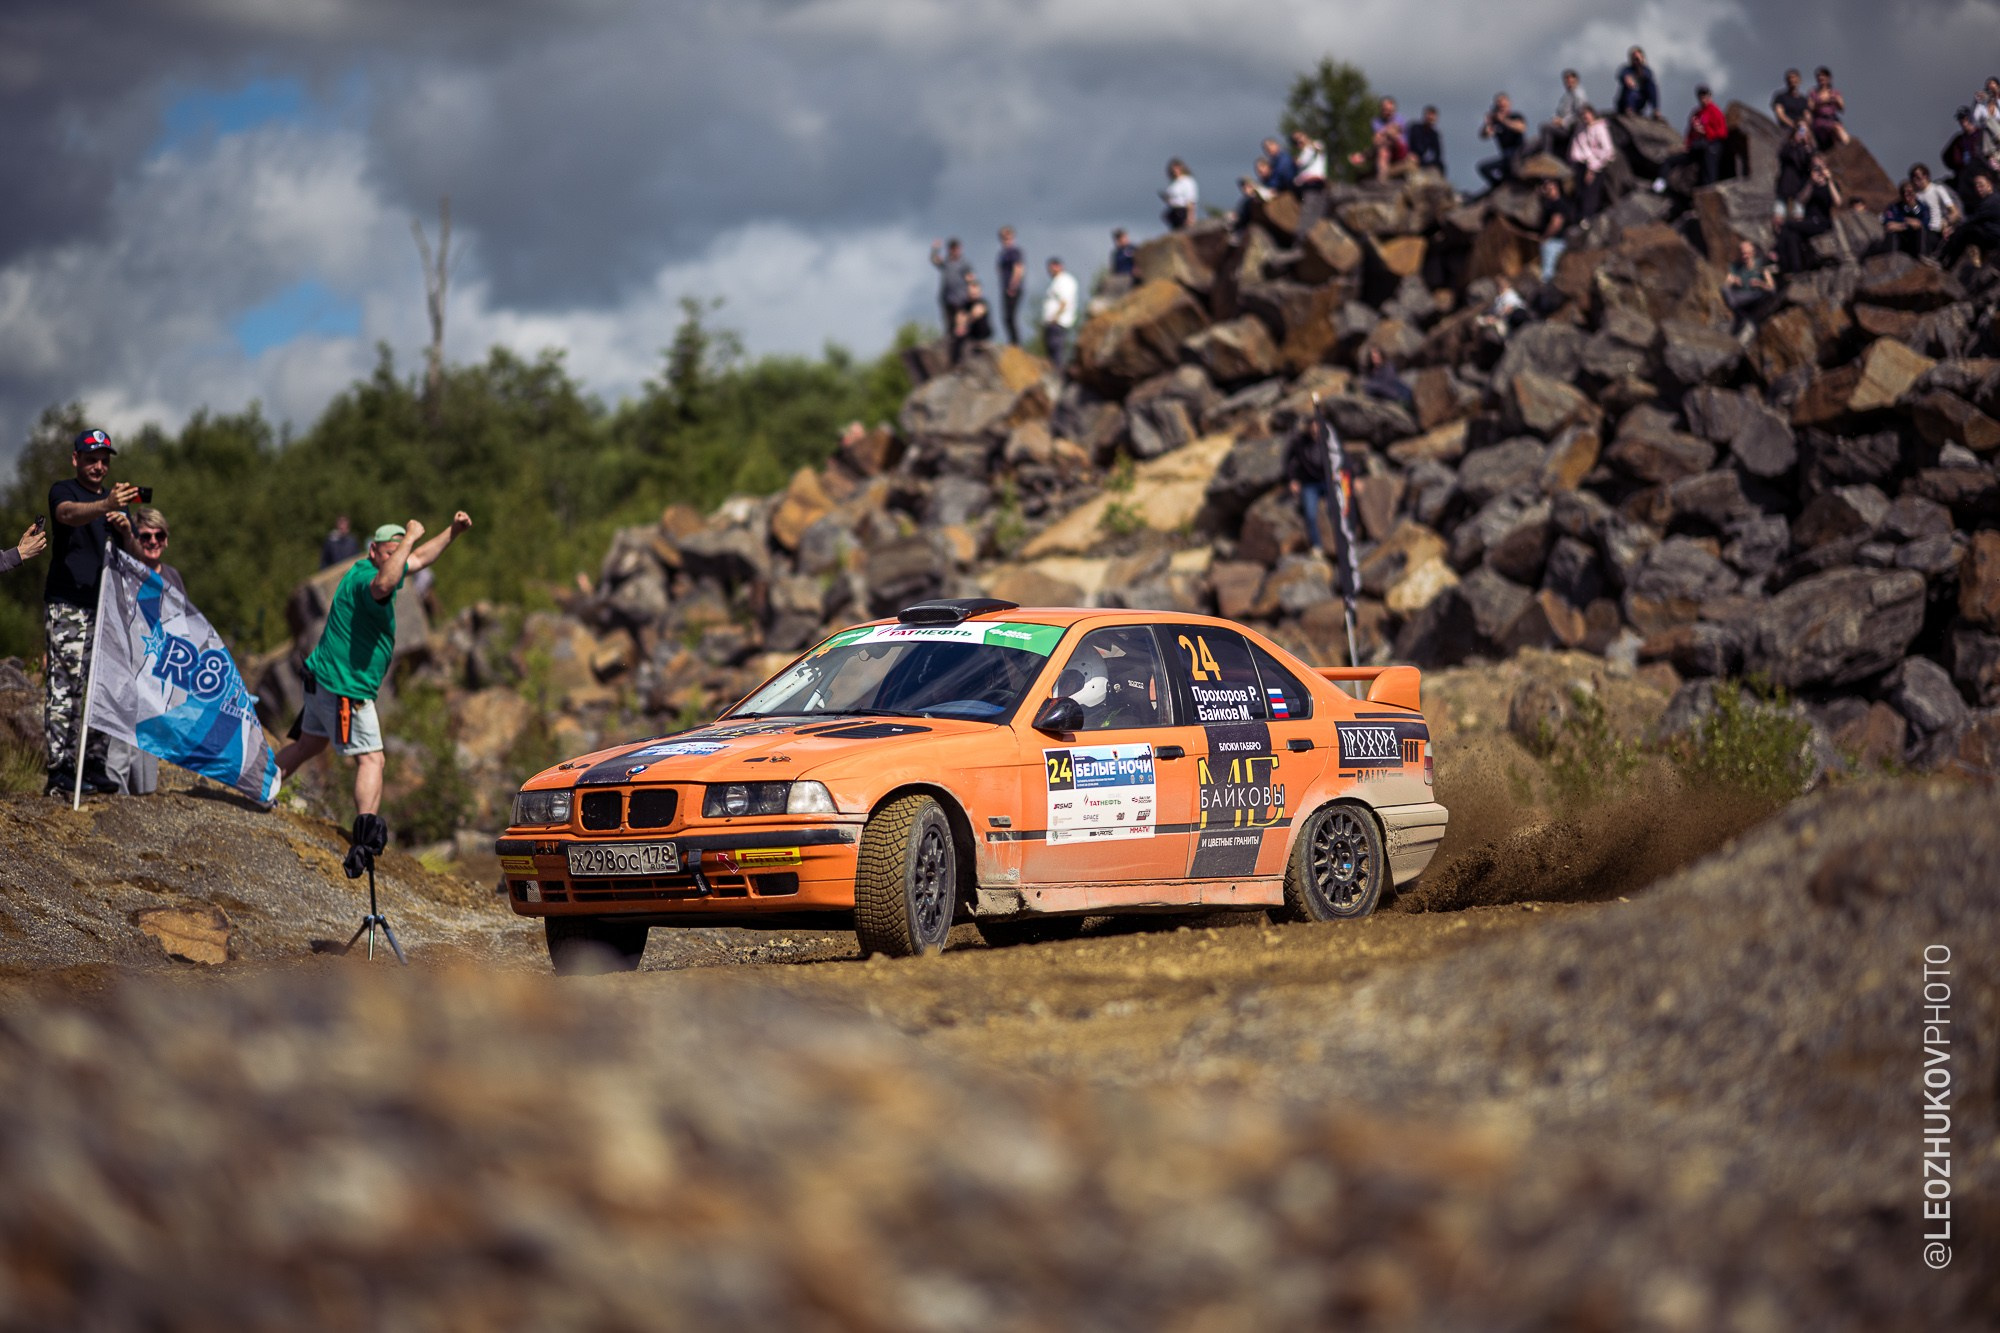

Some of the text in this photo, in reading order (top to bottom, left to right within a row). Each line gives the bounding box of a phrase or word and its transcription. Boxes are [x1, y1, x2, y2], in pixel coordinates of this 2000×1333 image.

[888, 629, 972, 637] ТАТНЕФТЬ
[1178, 634, 1222, 681] 24
[1191, 686, 1260, 705] Прохоров Р.
[1197, 704, 1253, 721] Байков М.
[1218, 741, 1262, 752] БЛОКИ ГАББРО
[1047, 757, 1073, 784] 24
[1075, 758, 1153, 778] БЕЛЫЕ НОЧИ
[1357, 769, 1388, 784] RALLY
[1089, 799, 1122, 807] ТАТНЕФТЬ
[1200, 783, 1285, 809] БАЙКОВЫ
[1201, 836, 1260, 848] И ЦВЕТНЫЕ ГРАНИТЫ
[642, 846, 671, 864] 178
[650, 863, 666, 871] RUS
